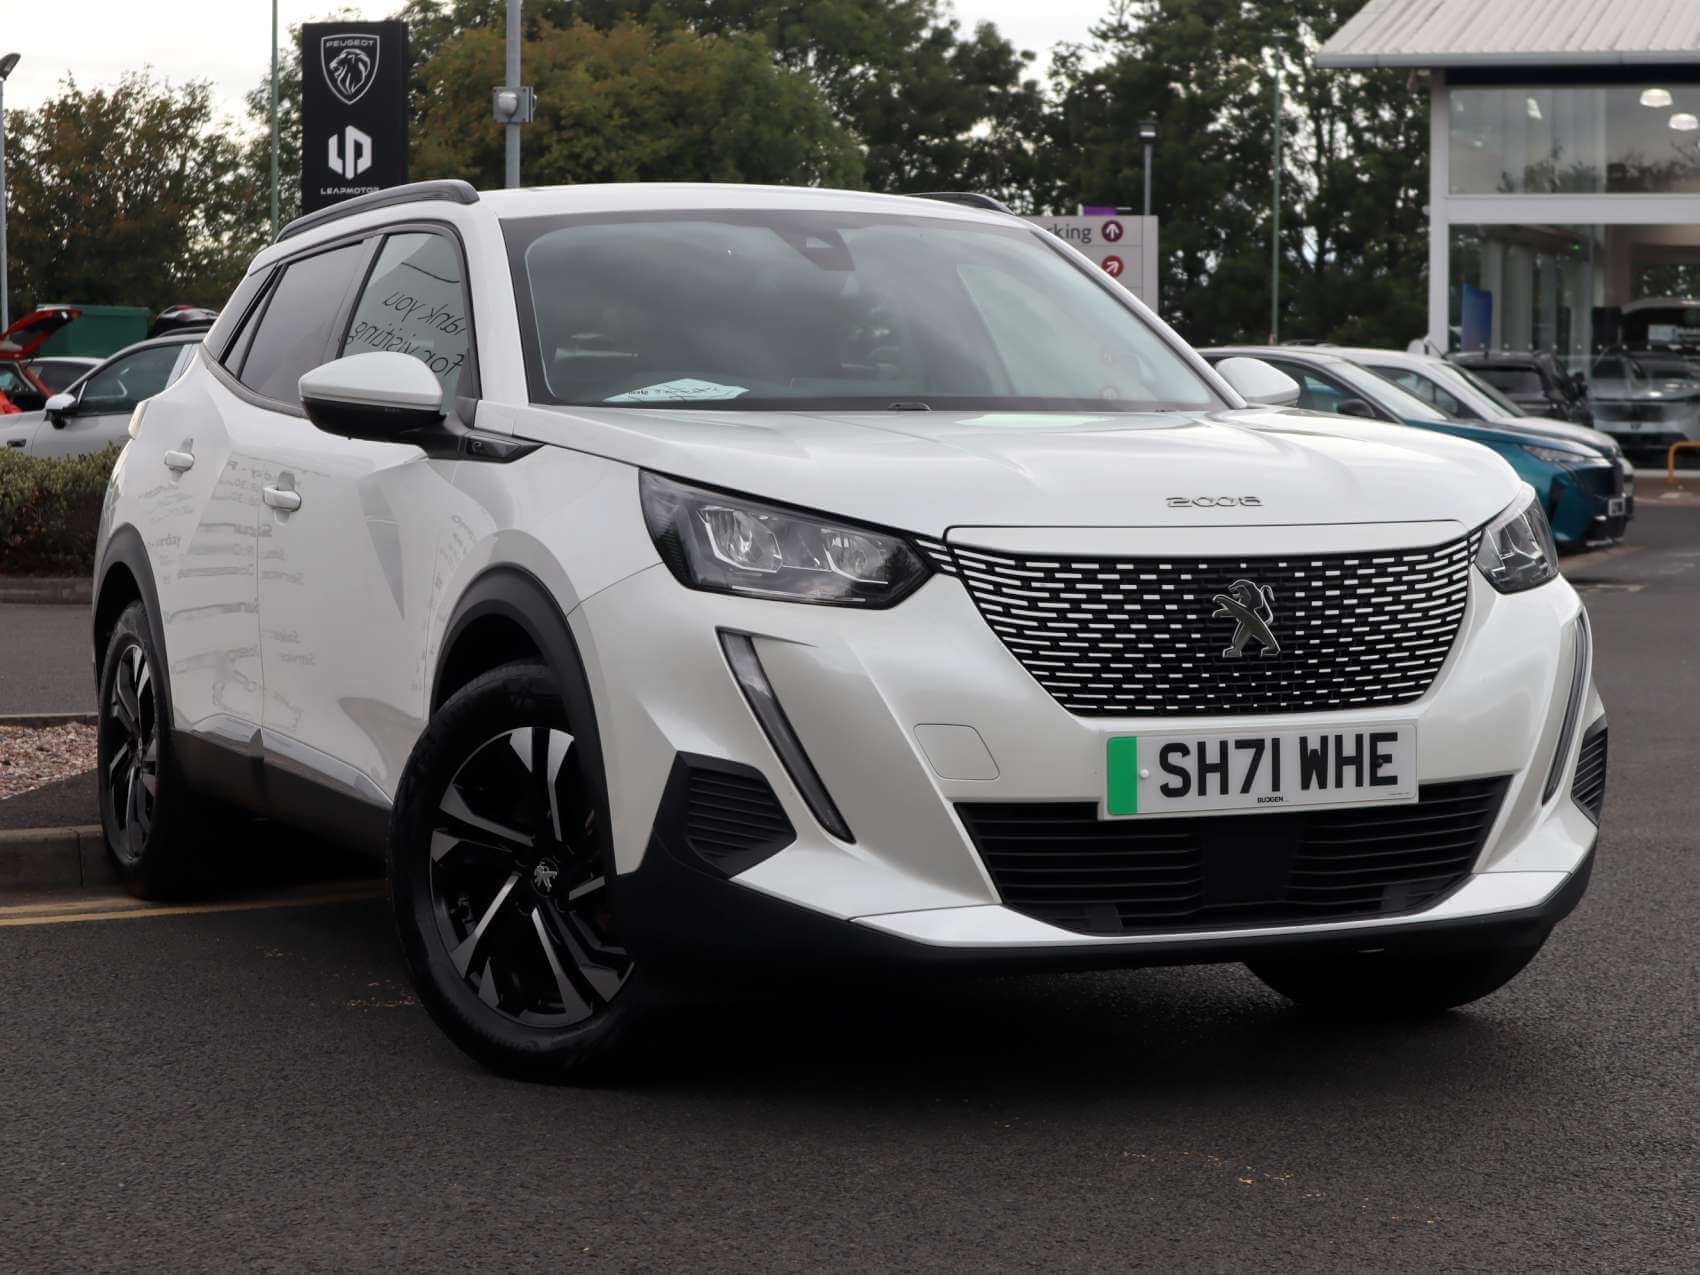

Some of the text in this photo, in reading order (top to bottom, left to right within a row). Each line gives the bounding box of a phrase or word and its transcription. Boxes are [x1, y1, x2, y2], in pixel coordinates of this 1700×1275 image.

[325, 39, 375, 48] PEUGEOT
[1165, 496, 1265, 508] 2008
[1159, 731, 1399, 798] SH71 WHE
